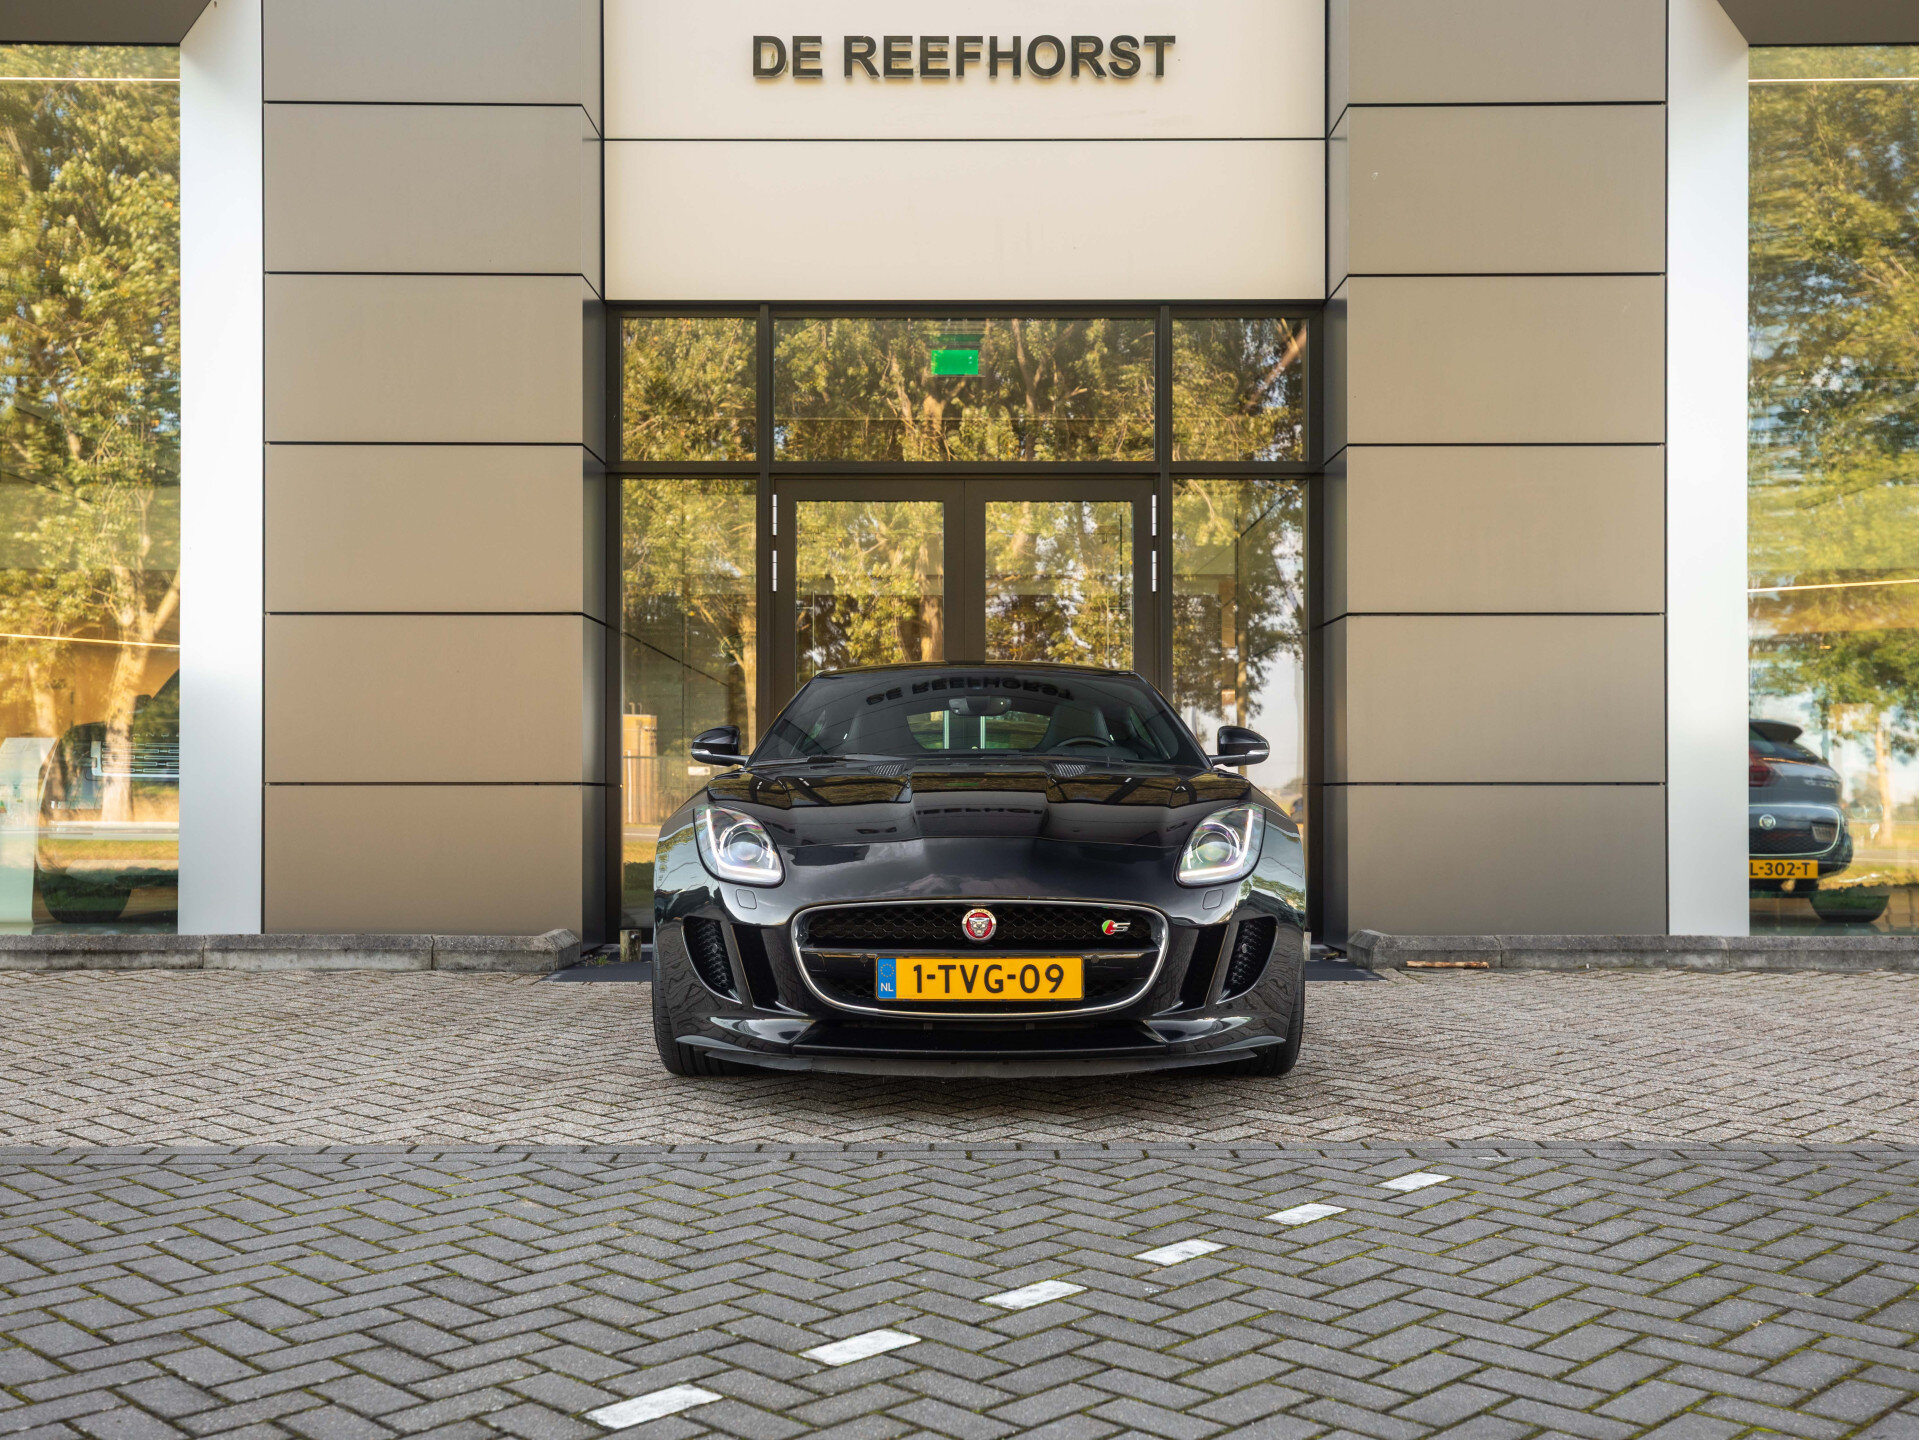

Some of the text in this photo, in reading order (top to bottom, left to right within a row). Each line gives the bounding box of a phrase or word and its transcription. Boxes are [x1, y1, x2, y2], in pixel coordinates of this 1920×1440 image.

[752, 34, 1177, 78] DE REEFHORST
[1750, 862, 1810, 875] L-302-T
[880, 964, 1064, 994] NL 1-TVG-09
